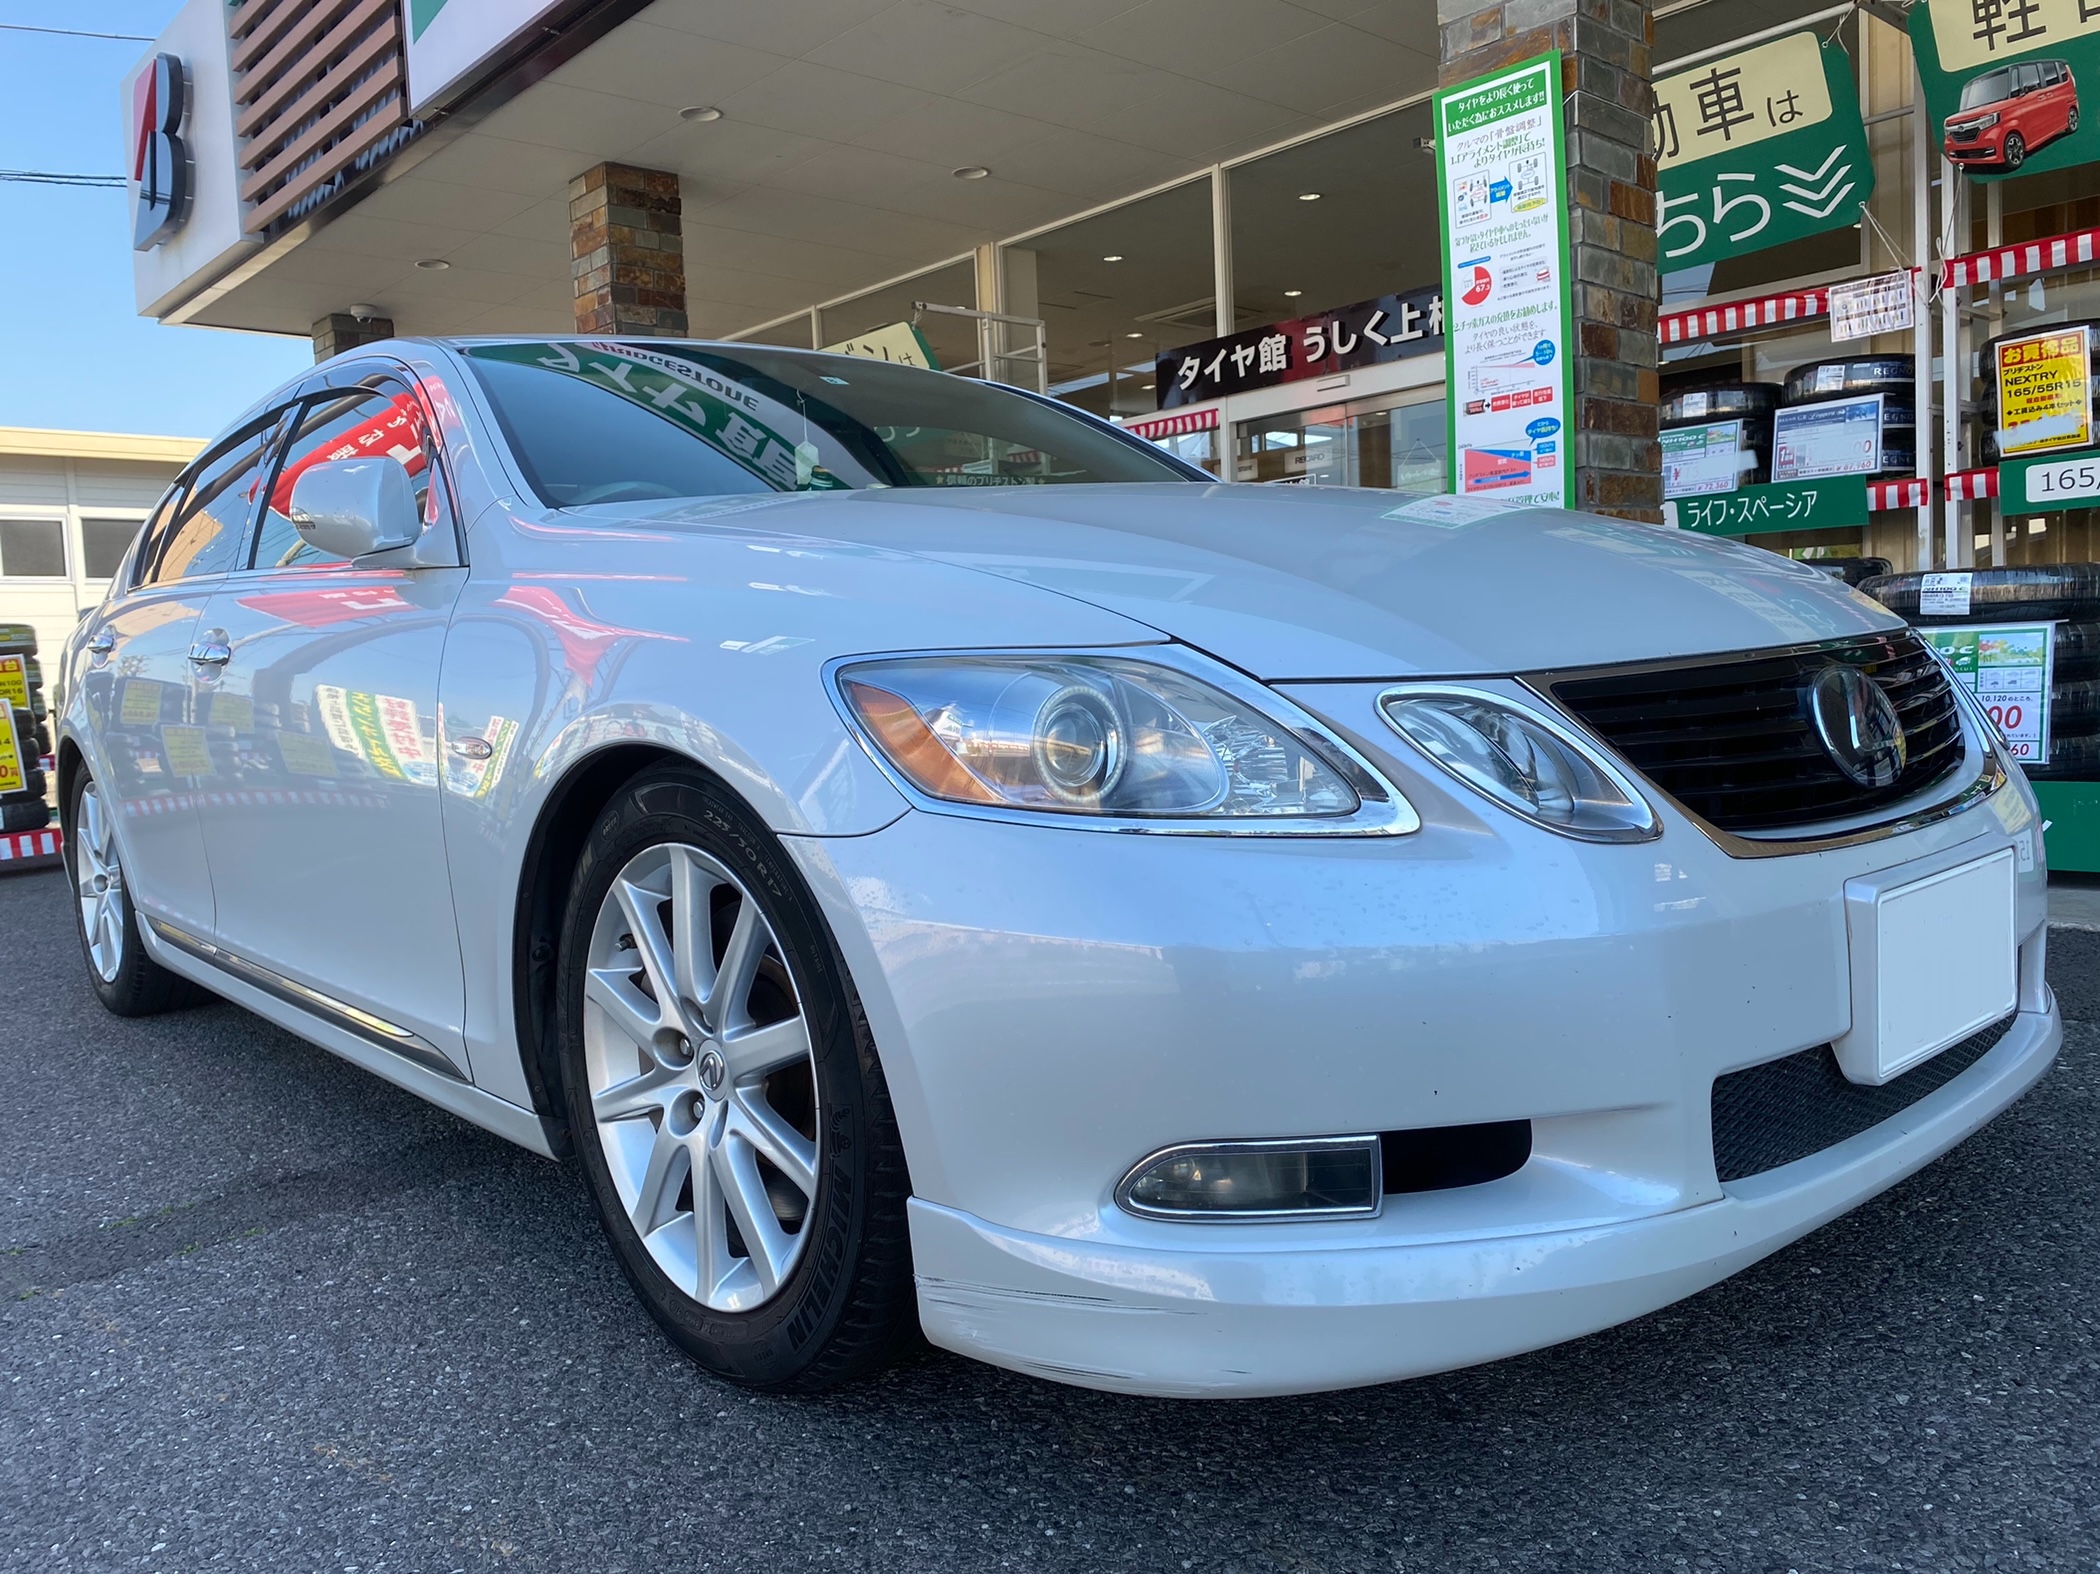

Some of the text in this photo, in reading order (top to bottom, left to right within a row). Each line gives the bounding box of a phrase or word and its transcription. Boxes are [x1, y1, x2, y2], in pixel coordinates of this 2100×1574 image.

[1458, 77, 1534, 113] タイヤをより長く使って
[1178, 333, 1287, 390] タイヤ館
[2003, 334, 2079, 365] お買得品
[1874, 366, 1913, 376] REGNO
[2005, 370, 2059, 387] NEXTRY
[2007, 379, 2082, 399] 165/55R15
[1661, 435, 1697, 444] NH100
[1687, 490, 1818, 527] ライフ・スペーシア
[787, 1165, 854, 1351] MICHELIN
